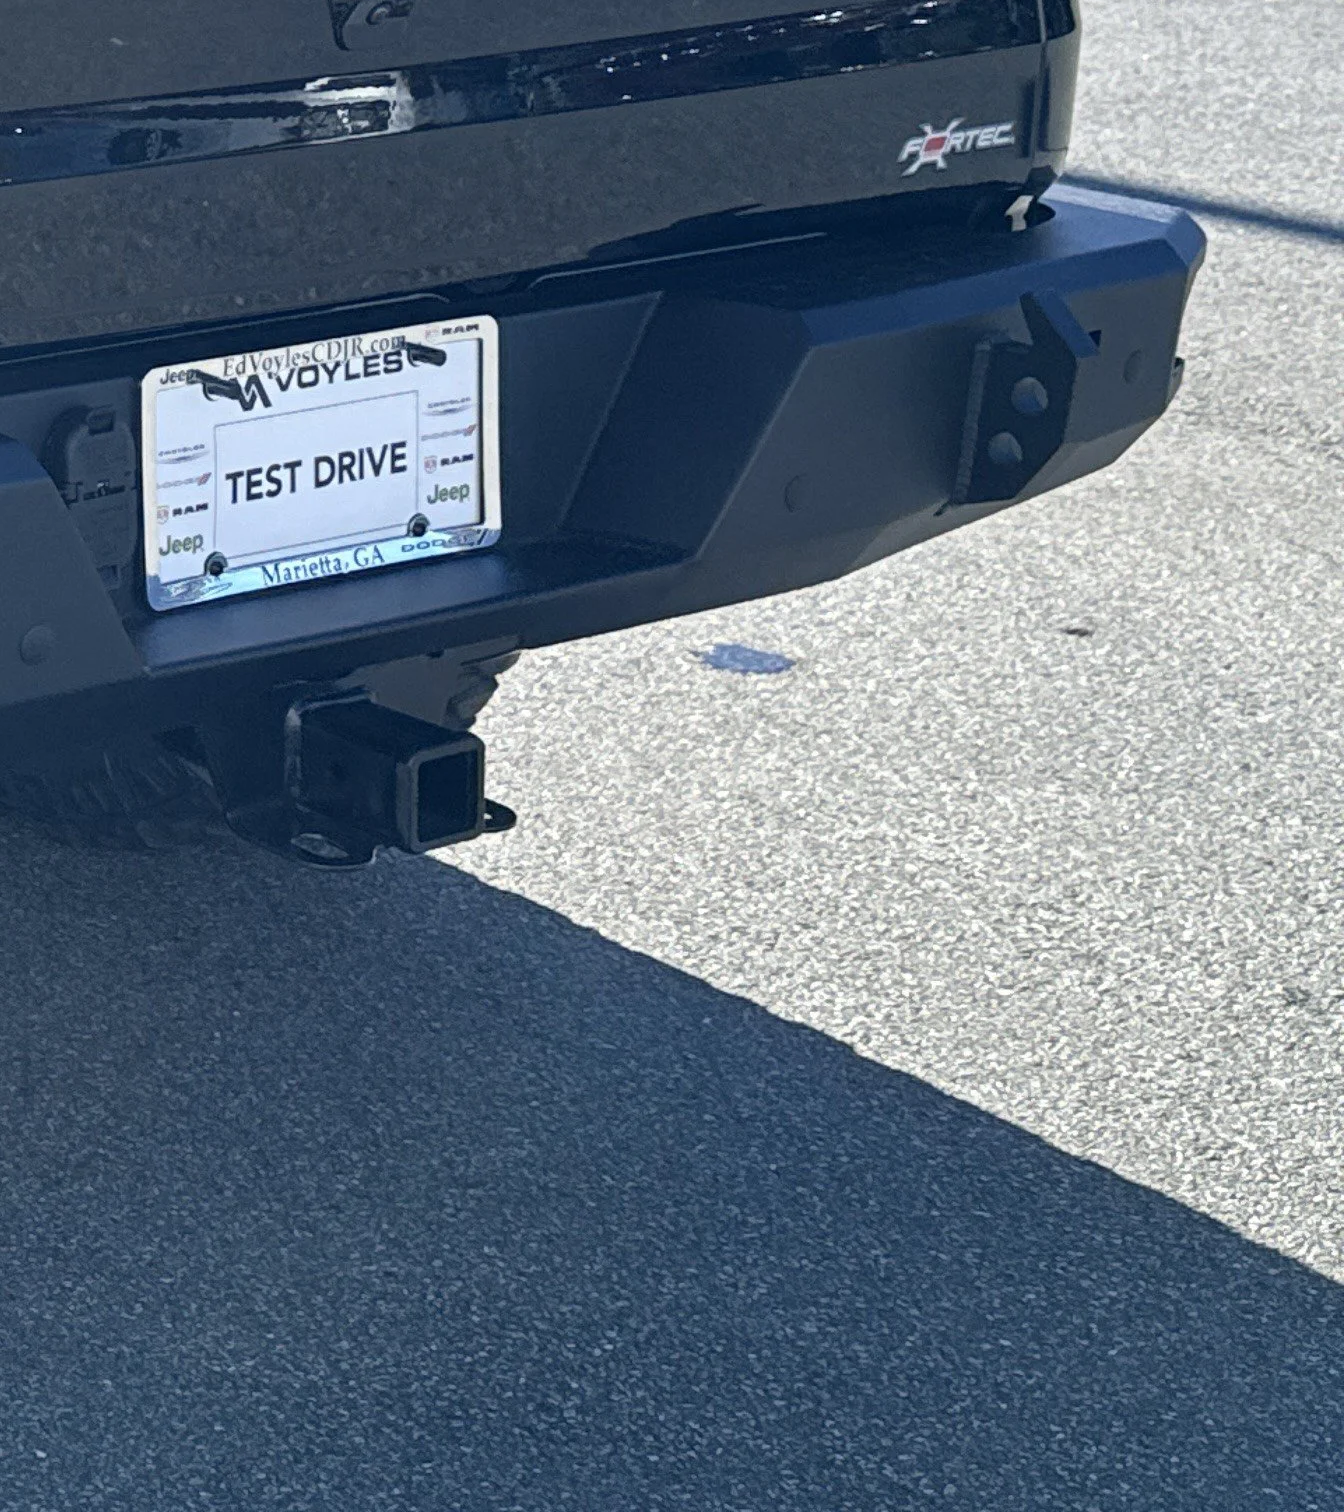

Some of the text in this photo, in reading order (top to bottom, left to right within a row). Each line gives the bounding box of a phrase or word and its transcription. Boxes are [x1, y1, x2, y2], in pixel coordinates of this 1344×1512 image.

[222, 335, 407, 378] EdVoylesCDJR.com
[159, 368, 196, 385] Jeep
[275, 349, 404, 392] VOYLES
[440, 453, 475, 467] RAM
[224, 441, 408, 505] TEST DRIVE
[426, 483, 472, 506] Jeep
[172, 502, 209, 517] RAM
[158, 533, 205, 557] Jeep
[261, 545, 386, 586] Marietta, GA
